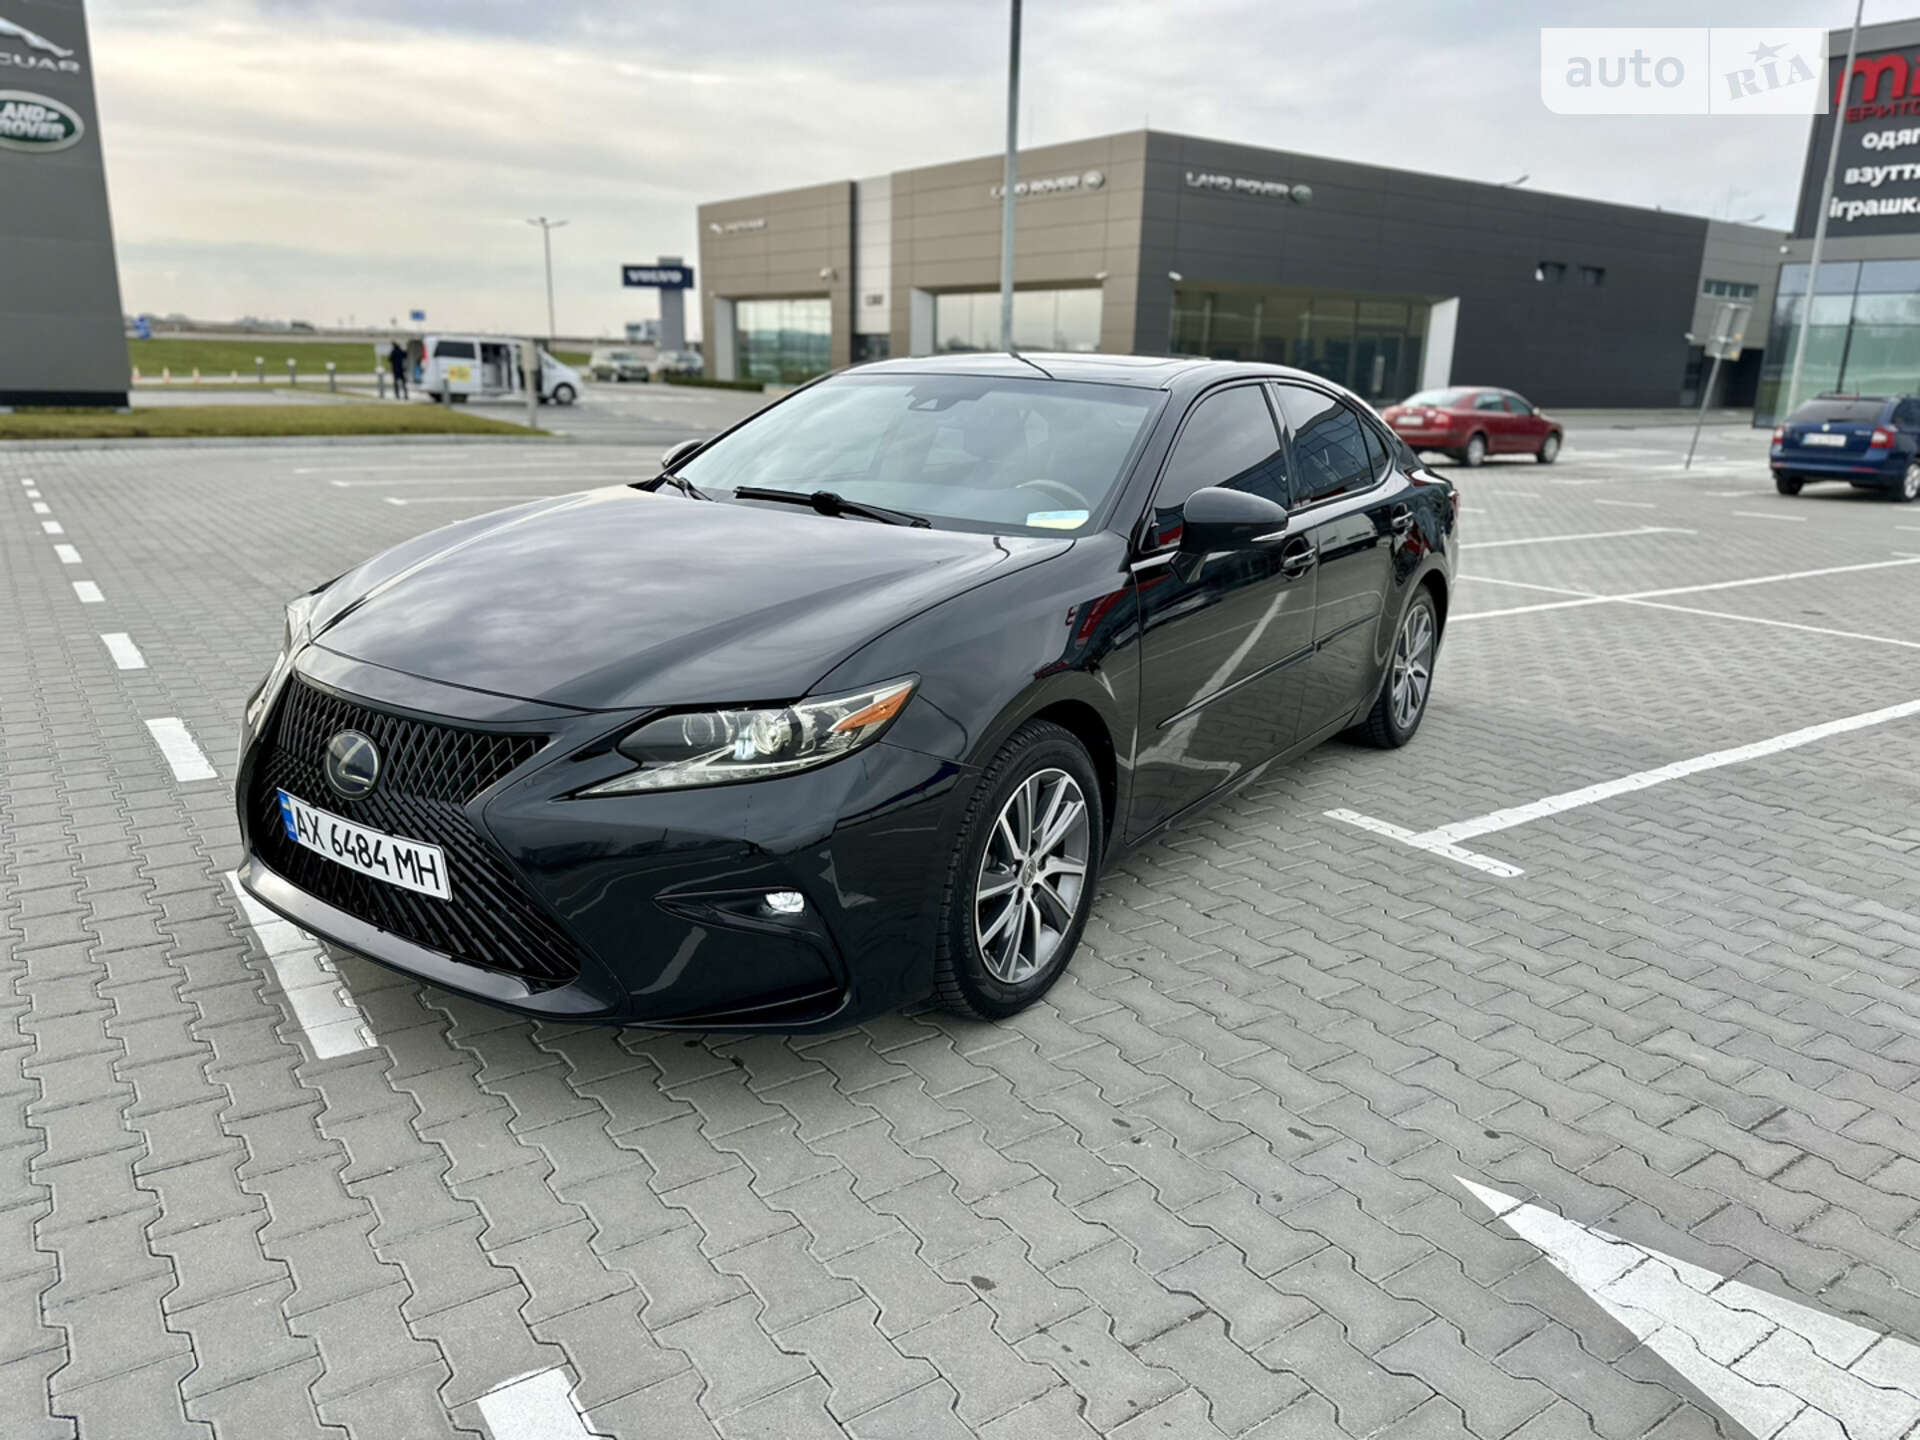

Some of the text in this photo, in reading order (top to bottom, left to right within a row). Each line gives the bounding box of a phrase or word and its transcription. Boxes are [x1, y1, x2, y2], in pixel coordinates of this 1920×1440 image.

[1185, 171, 1232, 191] LAND
[1235, 177, 1290, 198] ROVER
[1829, 197, 1920, 222] іграшк
[295, 806, 441, 890] AX 6484 MH
